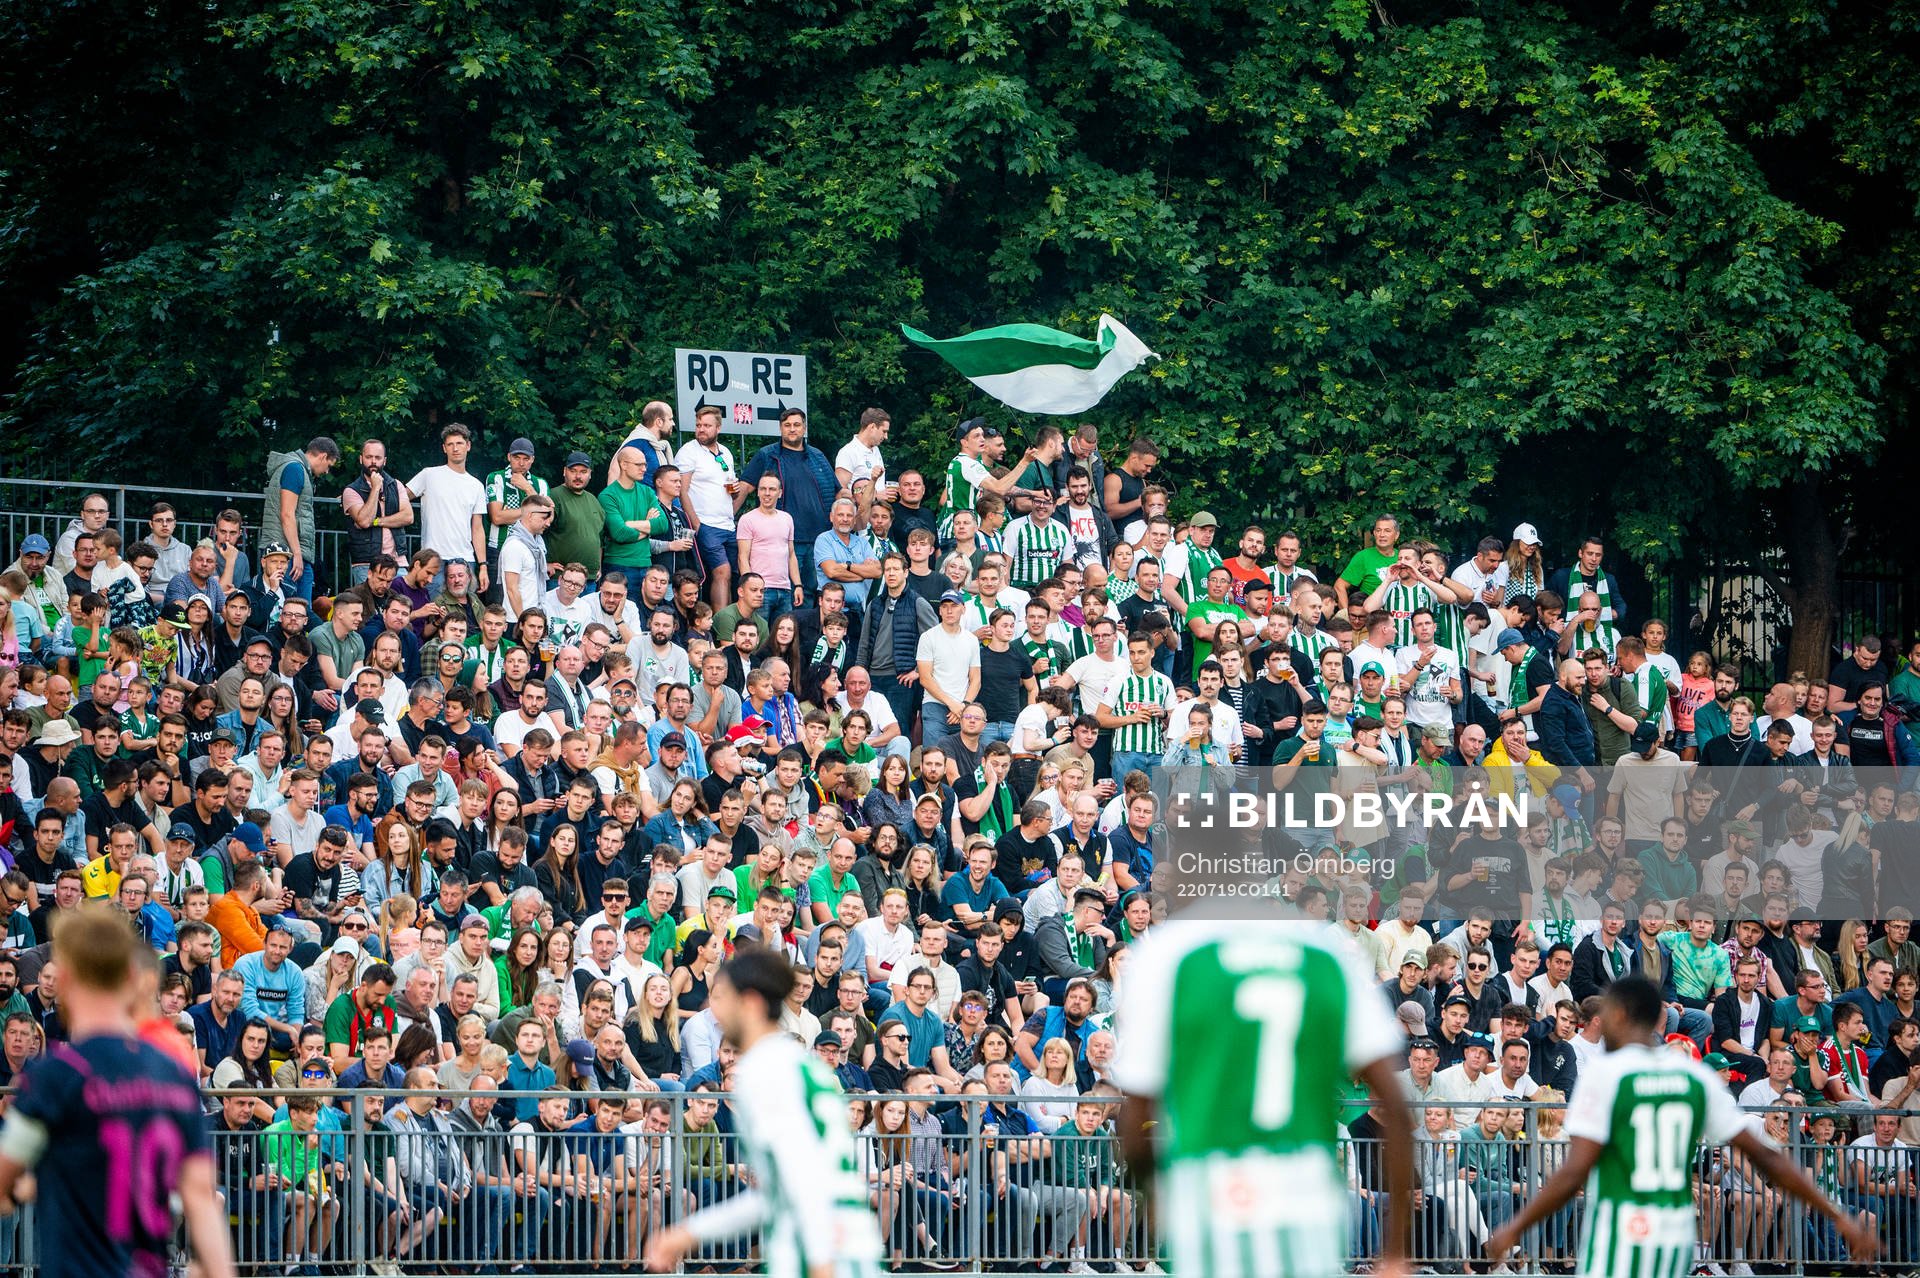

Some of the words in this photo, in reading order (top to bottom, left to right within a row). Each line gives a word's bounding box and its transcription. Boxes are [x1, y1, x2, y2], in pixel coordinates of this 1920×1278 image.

[688, 353, 729, 392] RD
[752, 357, 793, 396] RE
[1028, 550, 1053, 558] betsafe
[1631, 1102, 1693, 1191] 10
[98, 1118, 184, 1243] 10
